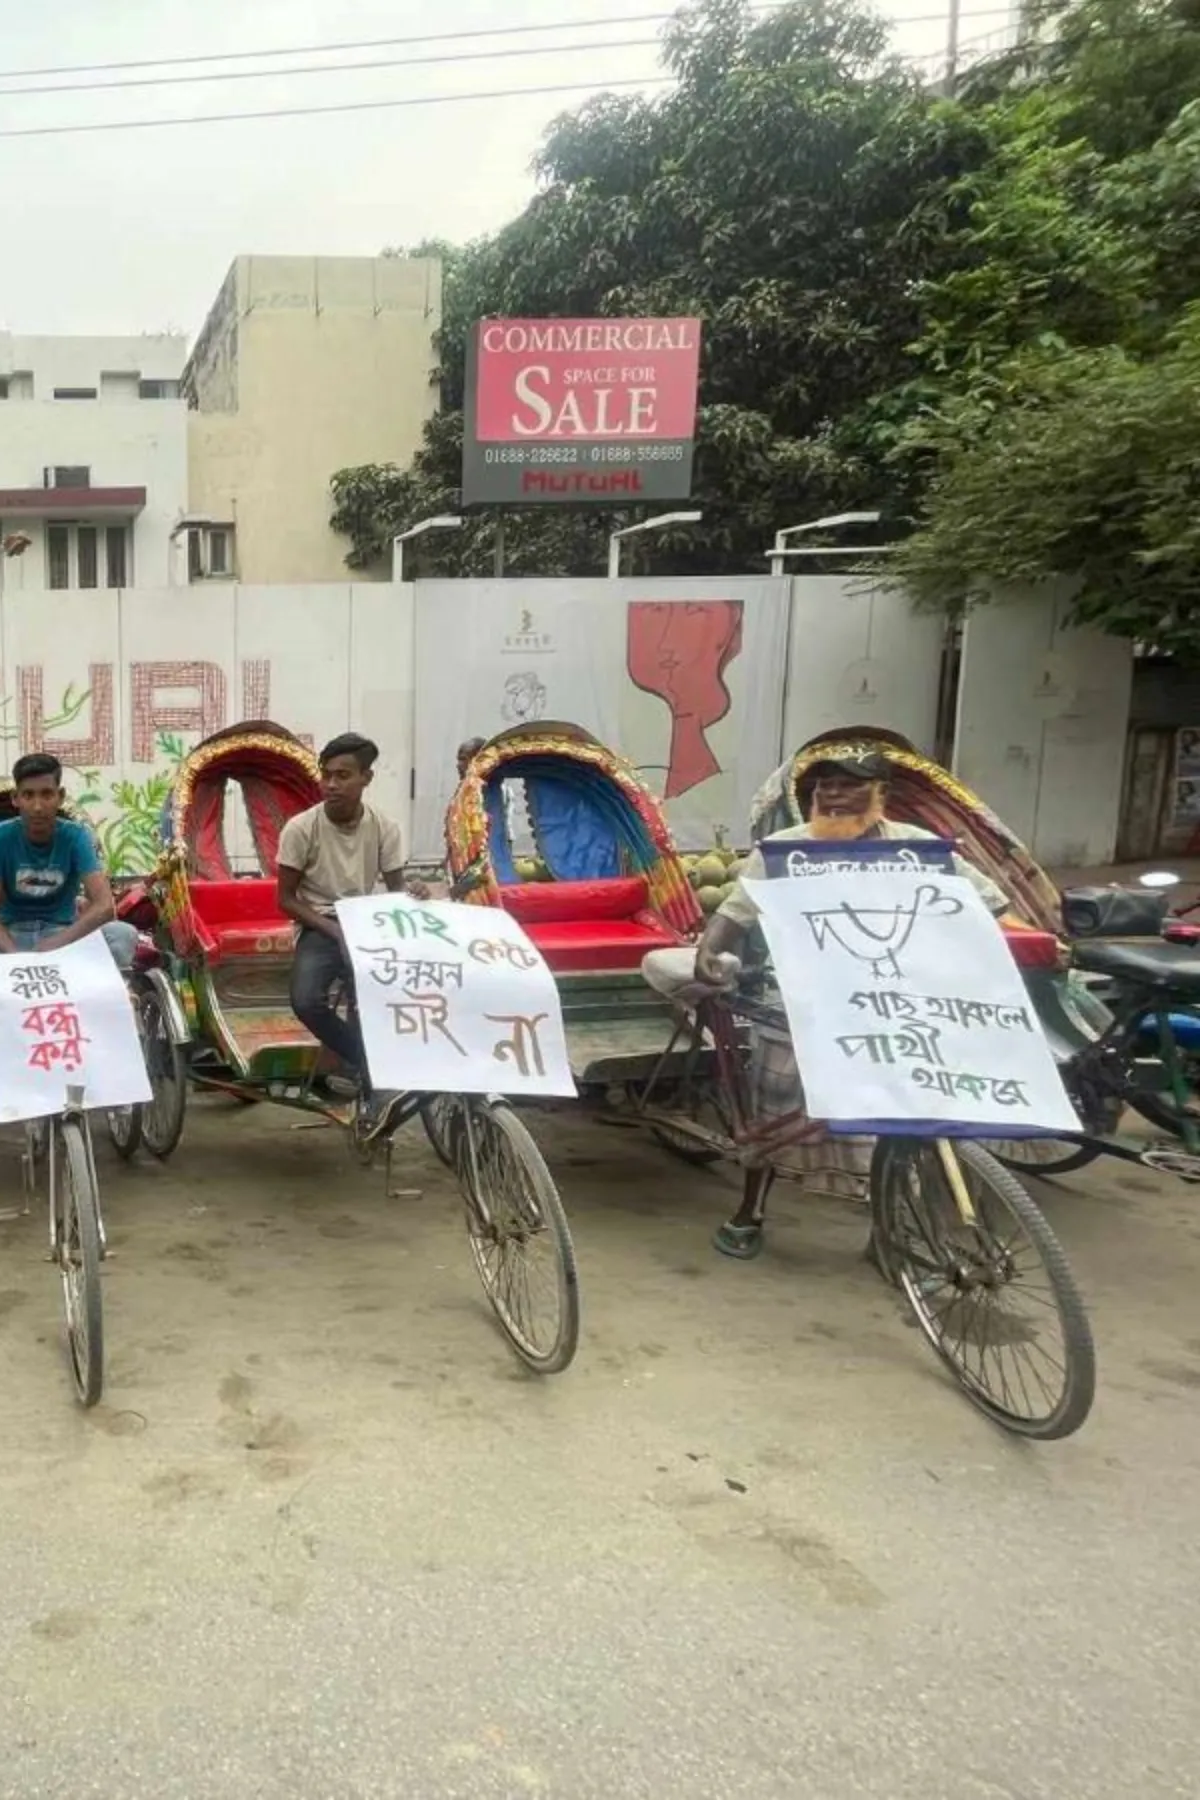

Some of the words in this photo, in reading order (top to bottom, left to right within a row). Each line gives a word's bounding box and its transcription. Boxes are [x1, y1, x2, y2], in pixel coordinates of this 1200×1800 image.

[483, 324, 693, 353] COMMERCIAL
[563, 367, 616, 385] SPACE
[620, 366, 656, 384] FOR
[511, 364, 658, 436] SALE
[522, 469, 643, 494] MUTUAL
[372, 908, 458, 946] গাছ
[386, 988, 468, 1056] চাই
[483, 1012, 549, 1077] না
